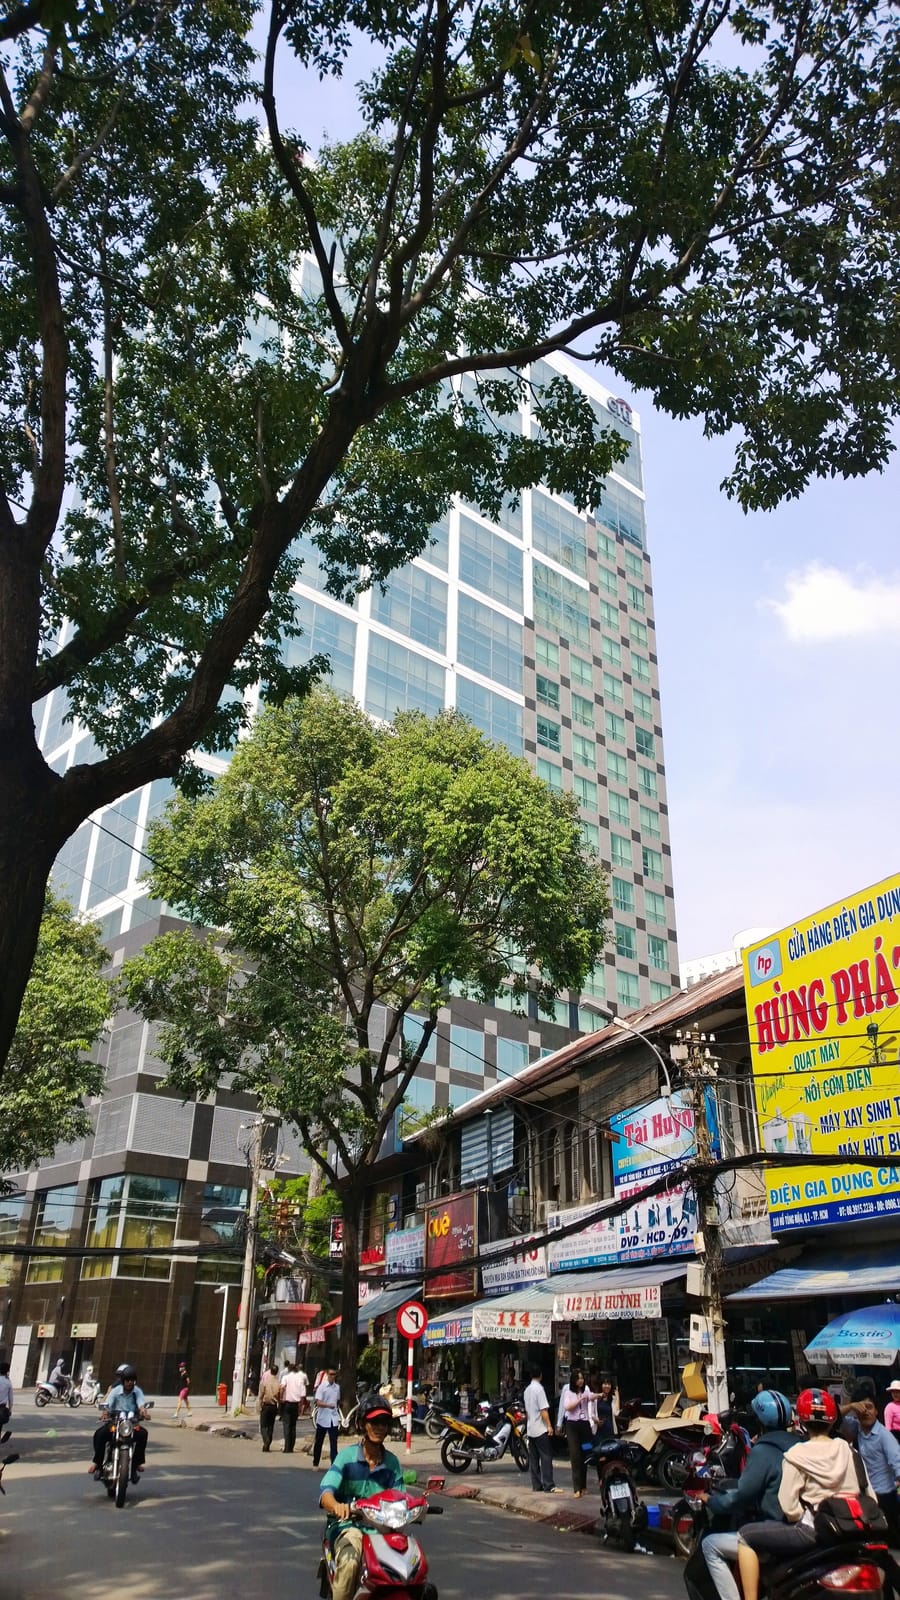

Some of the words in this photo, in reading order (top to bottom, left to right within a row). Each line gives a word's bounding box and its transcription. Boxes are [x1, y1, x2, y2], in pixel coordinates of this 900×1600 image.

[807, 921, 833, 953] HÀNG
[833, 907, 858, 941] ĐIỆN
[858, 901, 876, 930] GIA
[876, 888, 900, 923] DỤN
[820, 1039, 840, 1064] MÁY
[805, 1076, 821, 1103] NỒI
[824, 1075, 845, 1098] CƠM
[847, 1067, 872, 1092] ĐIỆN
[820, 1109, 840, 1134] MÁY
[843, 1106, 863, 1127] XAY
[866, 1099, 892, 1123] SINH
[893, 1096, 900, 1117] T
[624, 1118, 648, 1149] Tài
[652, 1109, 695, 1139] Huỳn
[864, 1131, 884, 1156] HÚT
[770, 1182, 801, 1205] ĐIỆN
[804, 1177, 828, 1201] GIA
[832, 1171, 874, 1199] DỤNG
[877, 1166, 900, 1186] CA
[621, 1235, 639, 1249] DVD
[646, 1230, 665, 1245] HCD
[566, 1297, 582, 1311] 112
[585, 1293, 602, 1310] TÀI
[605, 1290, 641, 1309] HUỲNH
[645, 1288, 658, 1301] 112
[497, 1312, 530, 1327] 114
[838, 1330, 886, 1338] Bostik
